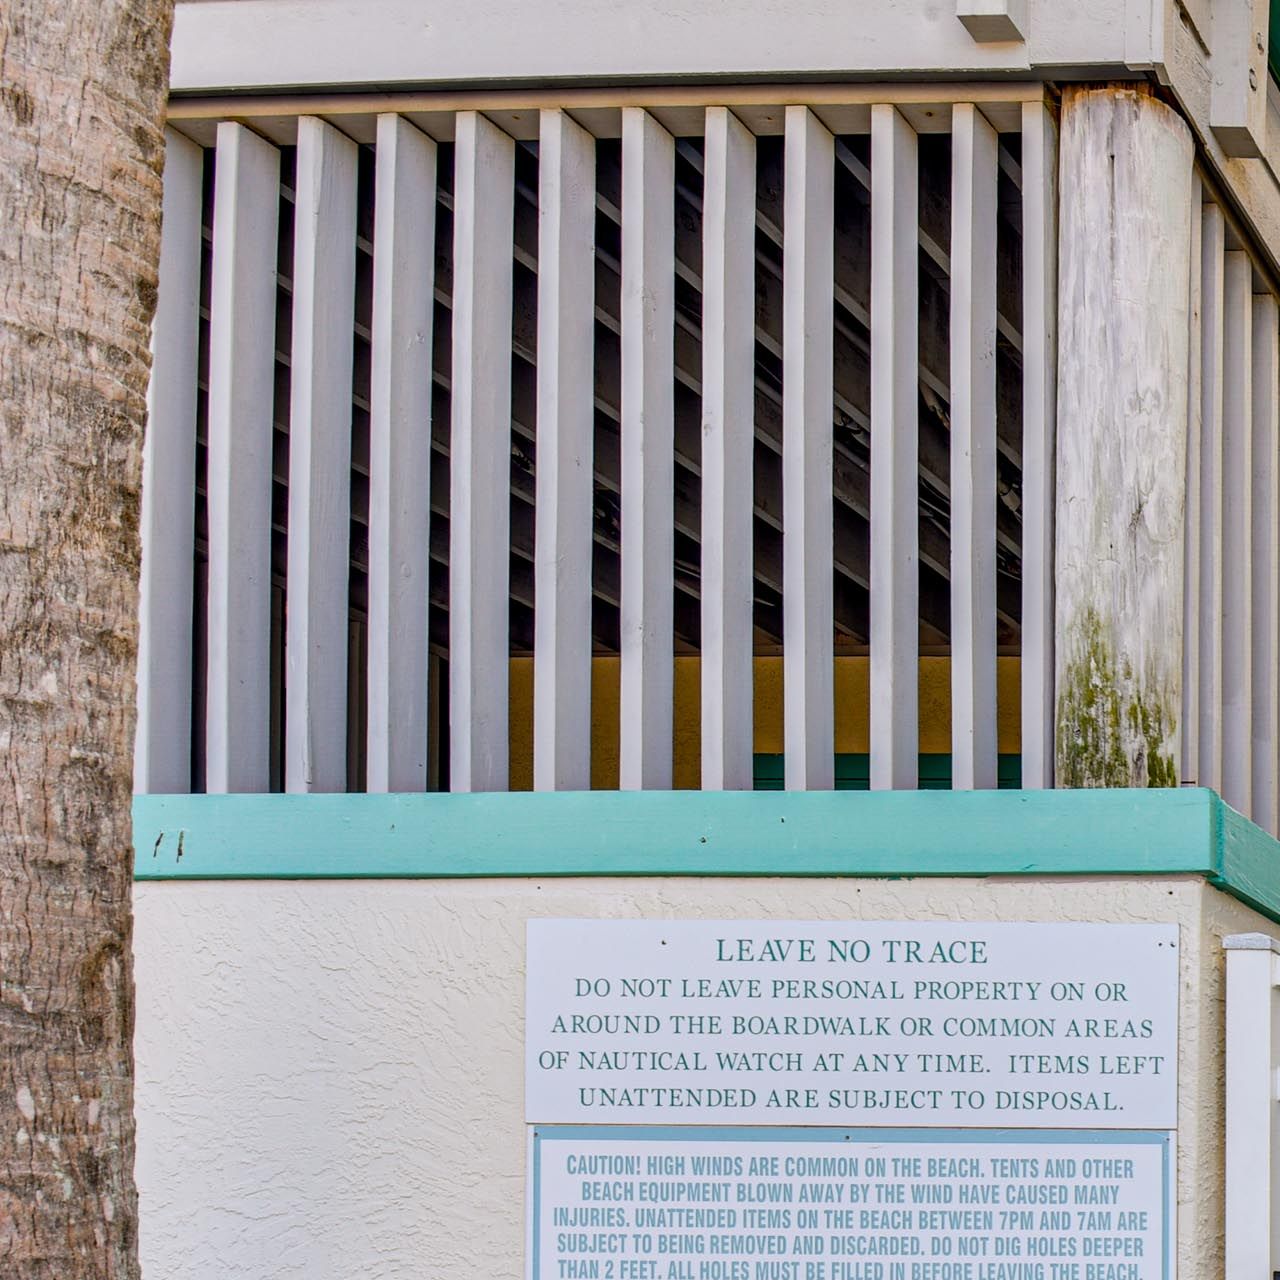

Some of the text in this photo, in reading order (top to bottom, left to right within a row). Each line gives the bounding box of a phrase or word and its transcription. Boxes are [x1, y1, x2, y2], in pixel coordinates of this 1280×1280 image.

[716, 938, 988, 964] LEAVE NO TRACE
[575, 978, 1129, 1002] DO NOT LEAVE PERSONAL PROPERTY ON OR
[550, 1014, 1153, 1039] AROUND THE BOARDWALK OR COMMON AREAS
[538, 1050, 1165, 1075] OF NAUTICAL WATCH AT ANY TIME. ITEMS LEFT
[578, 1087, 1124, 1111] UNATTENDED ARE SUBJECT TO DISPOSAL.
[566, 1154, 1134, 1180] CAUTION! HIGH WINDS ARE COMMON ON THE BEACH. TENTS AND OTHER
[581, 1180, 1120, 1205] BEACH EQUIPMENT BLOWN AWAY BY THE WIND HAVE CAUSED MANY
[553, 1206, 1149, 1232] INJURIES. UNATTENDED ITEMS ON THE BEACH BETWEEN 7PM AND 7AM ARE
[556, 1232, 1144, 1258] SUBJECT TO BEING REMOVED AND DISCARDED. DO NOT DIG HOLES DEEPER
[557, 1258, 600, 1280] THAN
[604, 1259, 615, 1280] 2
[619, 1259, 663, 1280] FEET.
[666, 1260, 696, 1280] ALL
[699, 1260, 751, 1280] HOLES
